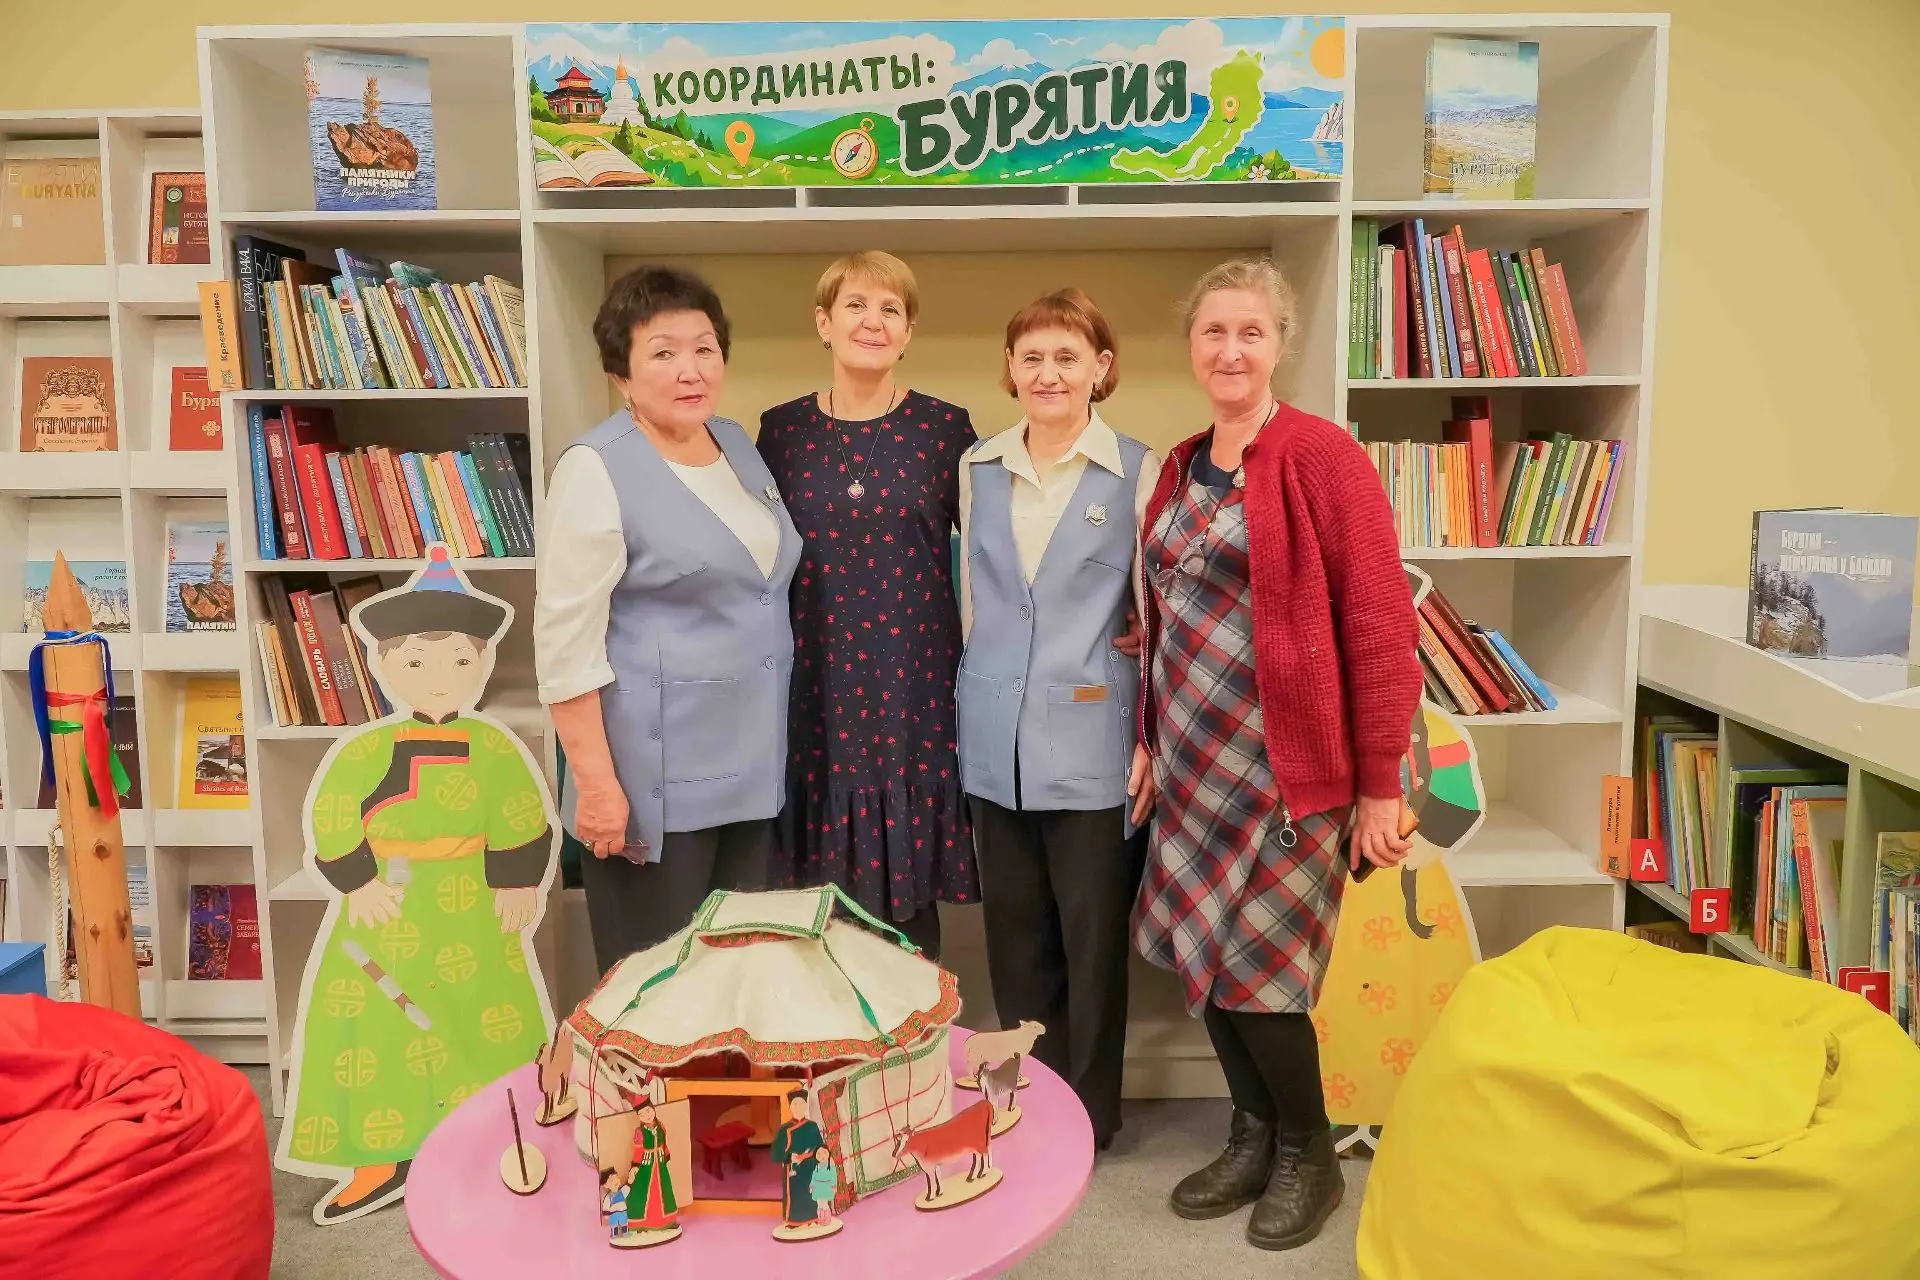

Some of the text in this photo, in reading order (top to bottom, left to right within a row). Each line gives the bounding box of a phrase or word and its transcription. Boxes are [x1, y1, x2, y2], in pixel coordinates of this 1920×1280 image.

[653, 52, 937, 107] КООРДИНАТЫ:
[899, 60, 1188, 170] БУРЯТИЯ
[340, 168, 416, 180] ПАМЯТНИКИ
[347, 178, 409, 189] ПРИРОДЫ
[212, 292, 229, 362] Краеведение
[1416, 298, 1429, 359] КНИГА ПАМЯТИ
[313, 648, 330, 690] СЛОВАРЬ
[1640, 848, 1658, 872] А
[1702, 898, 1718, 923] Б
